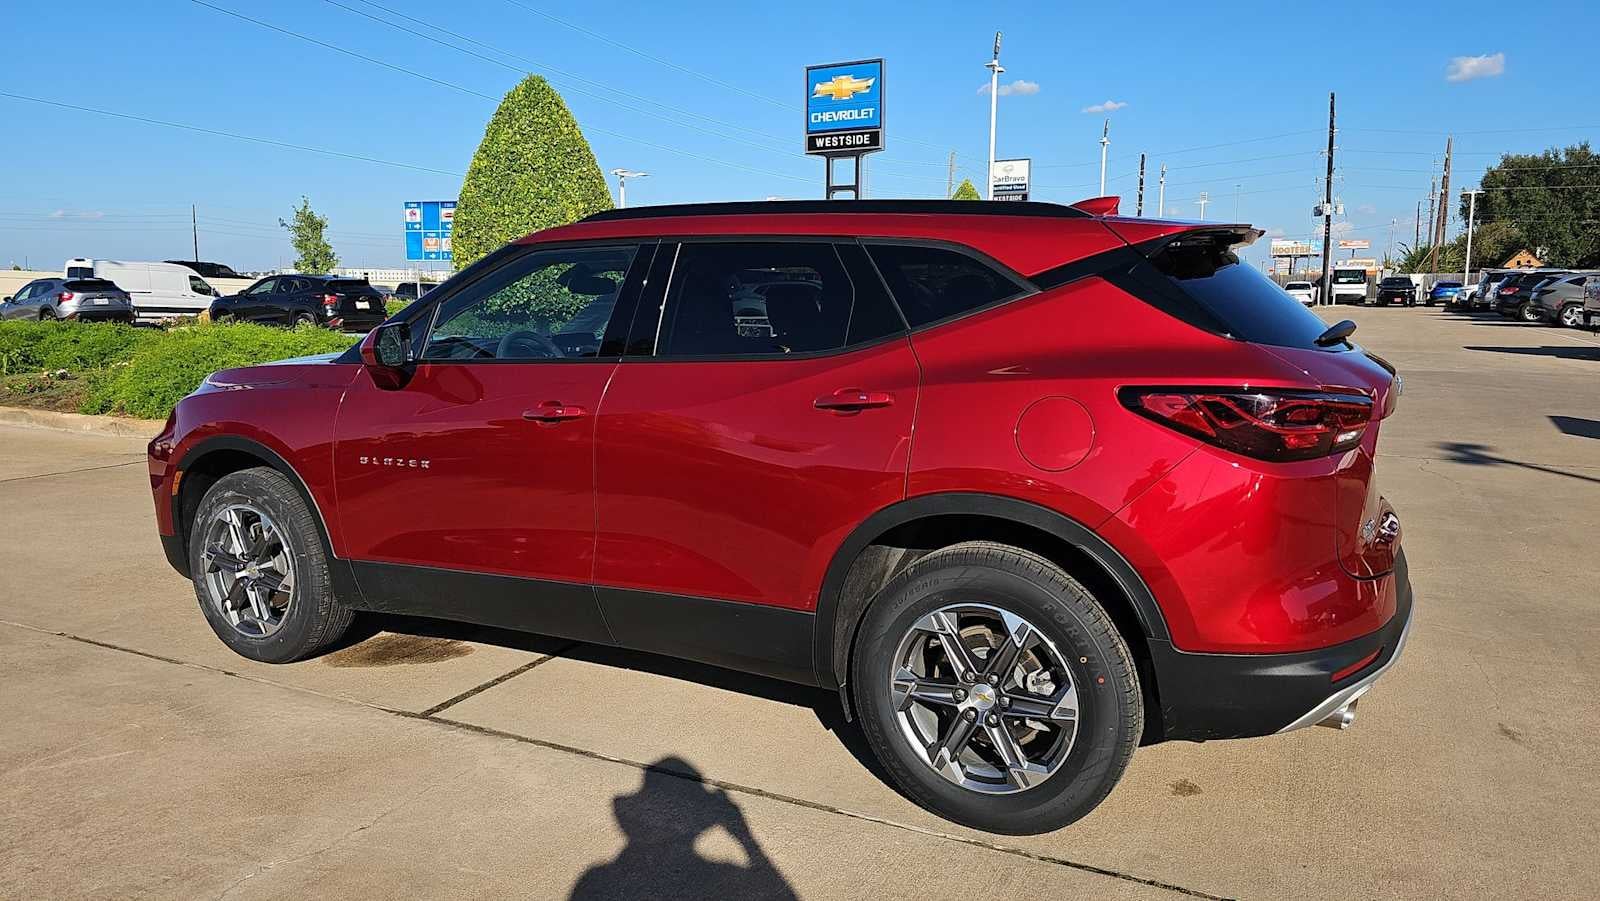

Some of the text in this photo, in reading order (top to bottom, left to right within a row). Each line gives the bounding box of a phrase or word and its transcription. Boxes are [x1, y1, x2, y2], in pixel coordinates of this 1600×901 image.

[811, 108, 874, 123] CHEVROLET
[815, 134, 871, 148] WESTSIDE
[993, 175, 1026, 183] CarBravo
[359, 456, 431, 469] BLAZER
